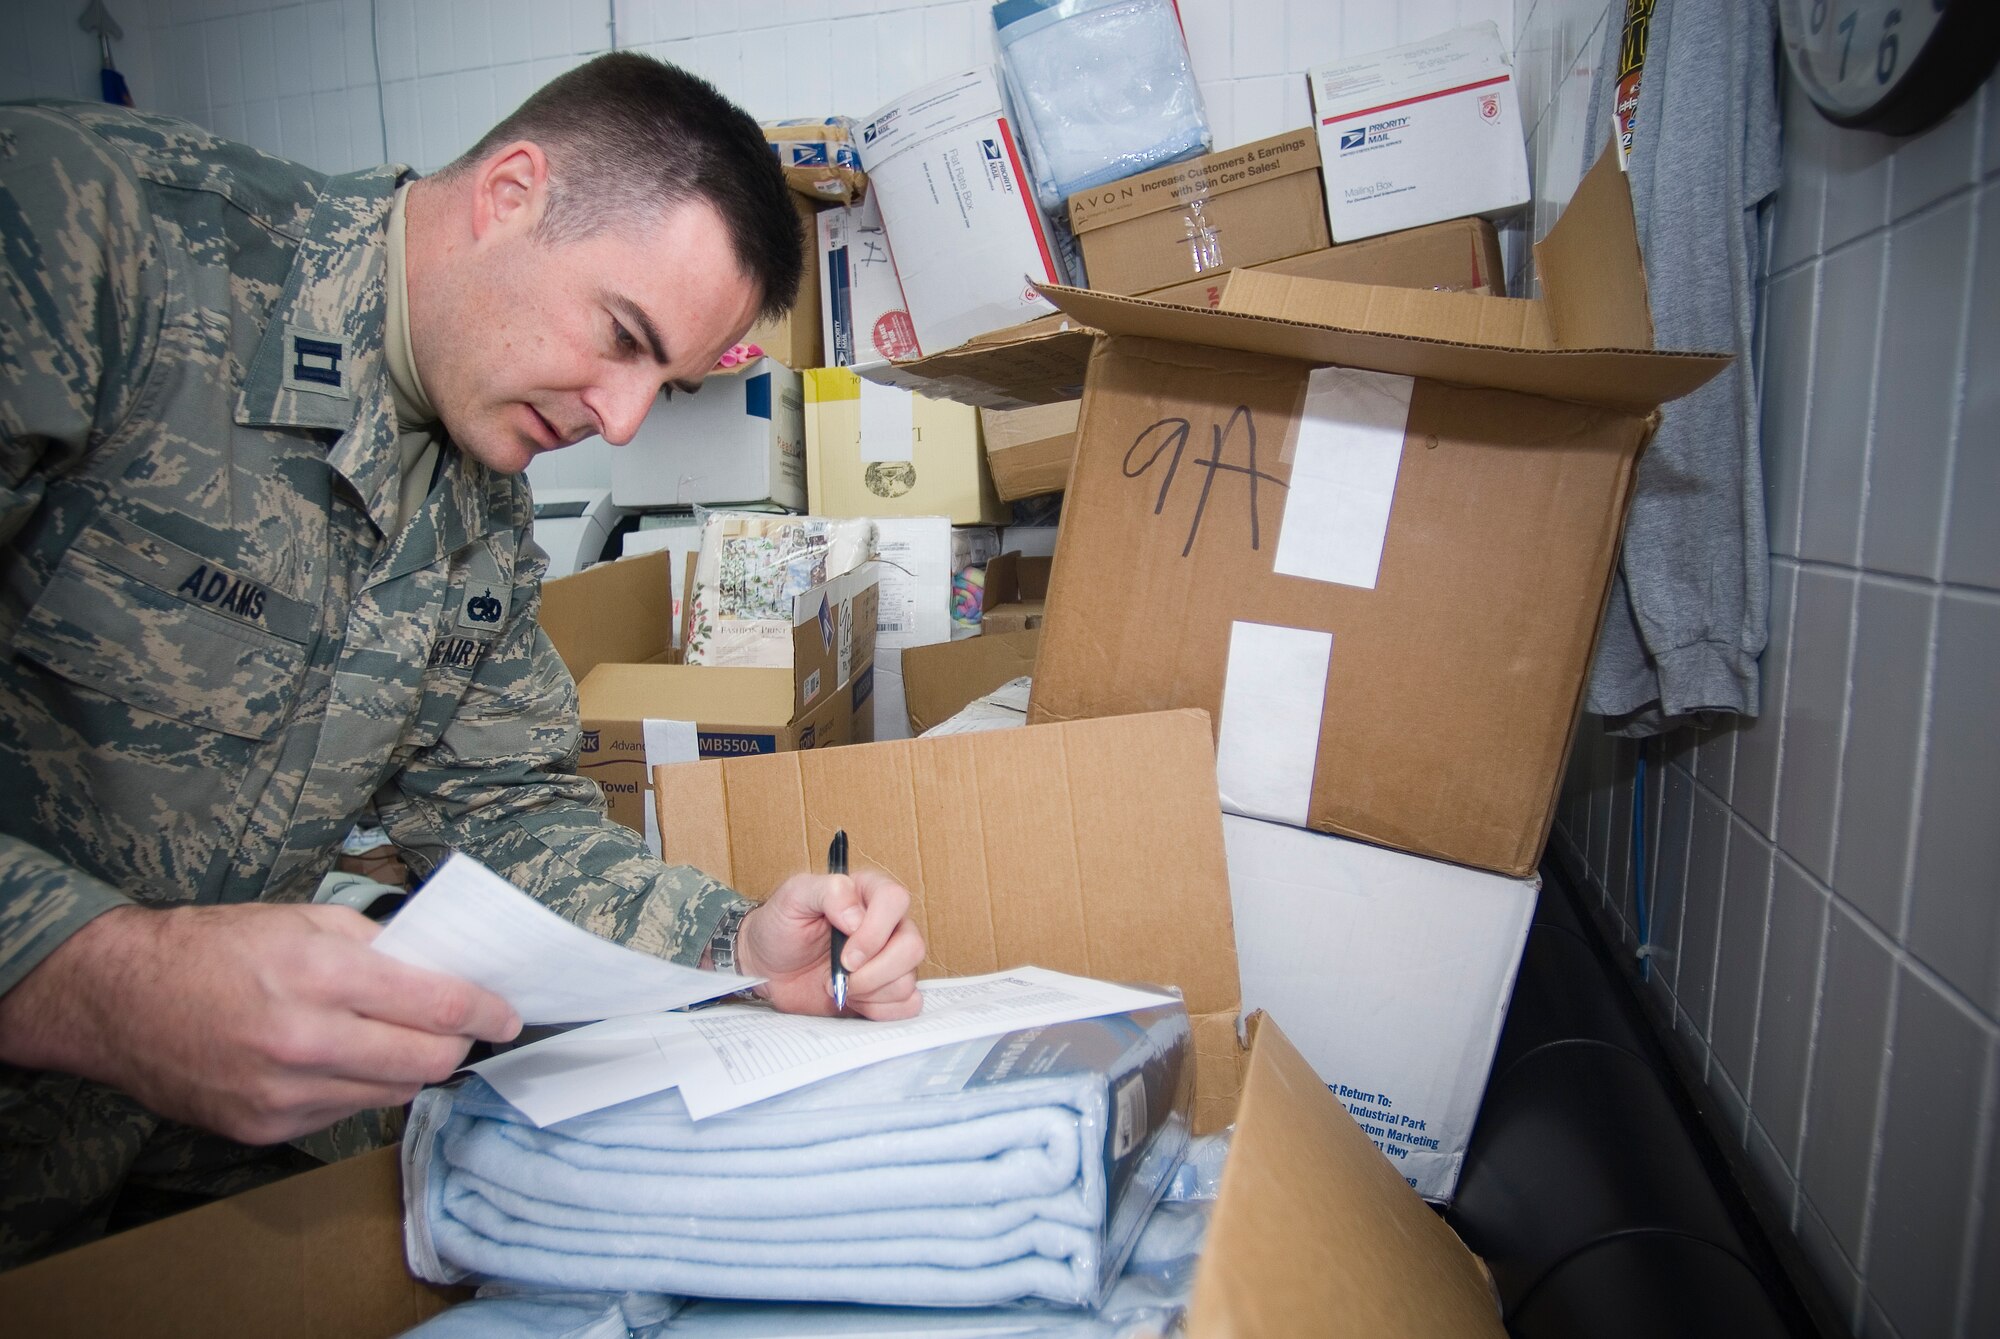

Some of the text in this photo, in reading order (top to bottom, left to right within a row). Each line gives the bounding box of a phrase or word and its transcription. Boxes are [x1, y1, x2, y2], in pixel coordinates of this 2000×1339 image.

[1838, 8, 1859, 83] 7
[1877, 8, 1902, 86] 6
[1368, 117, 1408, 133] PRIORITY
[1368, 133, 1391, 145] MAIL
[989, 162, 999, 180] MAIL
[998, 161, 1013, 192] PRIORITY
[1141, 138, 1306, 193] Increase Customers & Earnings
[955, 167, 968, 191] Rate
[962, 190, 975, 211] Box
[1170, 159, 1281, 200] with Skin Care Sales!
[1345, 180, 1394, 199] Mailing Box
[1075, 187, 1134, 213] AVON
[1122, 404, 1290, 558] 9A
[178, 565, 267, 621] ADAMS
[721, 626, 757, 635] FASHION
[442, 637, 475, 666] AIR
[580, 736, 597, 750] RK
[699, 738, 761, 754] MB550A
[599, 780, 639, 794] Towel
[1327, 1083, 1392, 1108] st Return To:
[1349, 1103, 1427, 1131] Industrial Park
[1358, 1122, 1440, 1150] stom Marketing
[1386, 1144, 1409, 1160] Hwy
